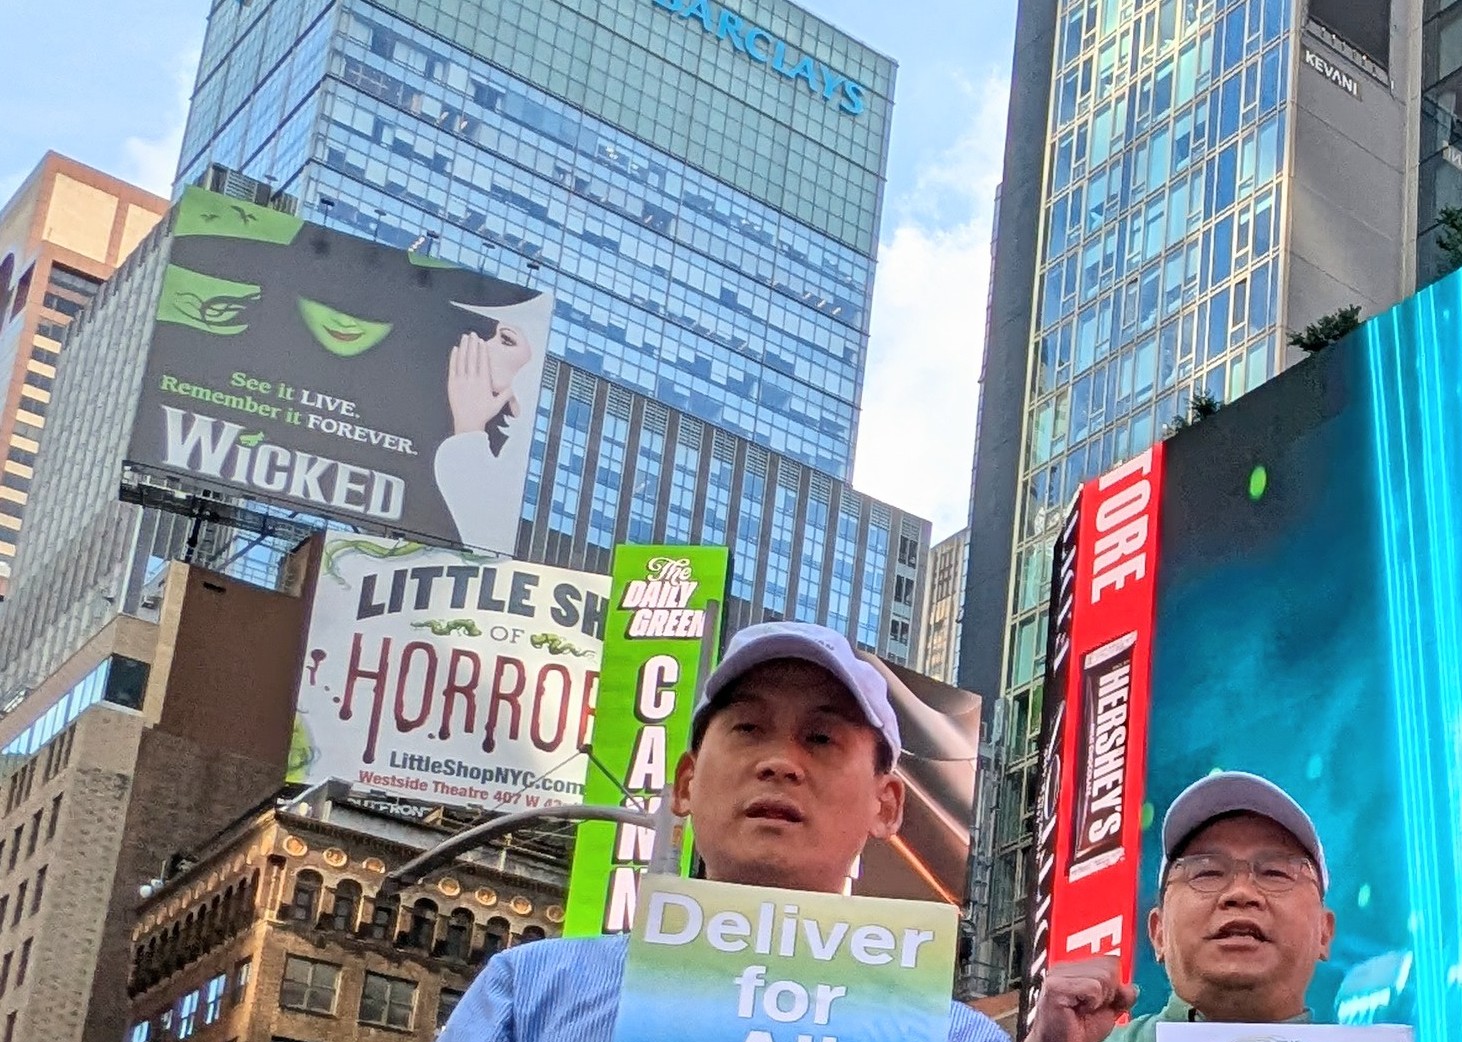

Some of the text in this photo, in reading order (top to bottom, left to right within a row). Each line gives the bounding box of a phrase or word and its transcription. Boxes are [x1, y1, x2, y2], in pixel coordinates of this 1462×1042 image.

[1305, 50, 1359, 96] KEVANI
[160, 374, 419, 456] Remember it FOREVER.
[230, 371, 361, 419] See it LIVE.
[647, 557, 693, 584] The
[356, 565, 609, 642] LITTLE SH
[620, 580, 698, 609] DAILY
[490, 625, 526, 644] OF
[627, 608, 706, 638] GREEN
[389, 750, 585, 796] LittleShopNYC.com
[1088, 664, 1131, 844] HERSHEY'S
[359, 769, 428, 792] Westside
[432, 780, 489, 801] Theatre
[493, 790, 521, 804] 407
[525, 794, 541, 808] W
[644, 890, 935, 969] Deliver
[732, 964, 848, 1025] for
